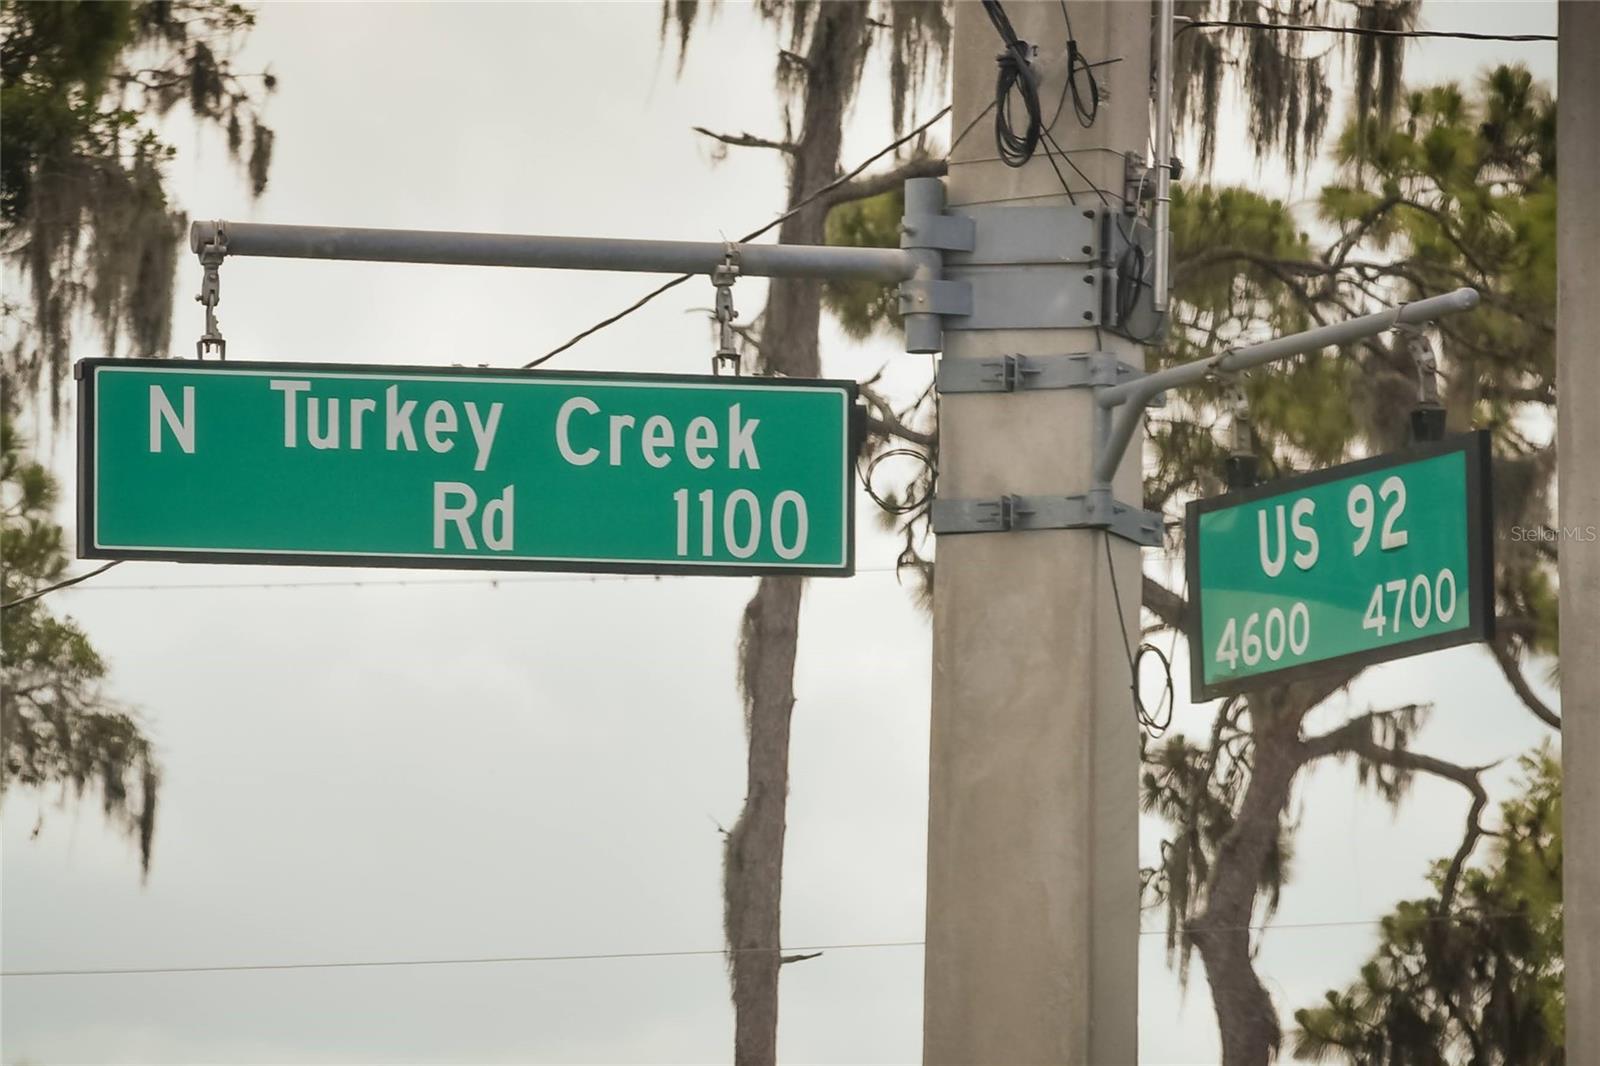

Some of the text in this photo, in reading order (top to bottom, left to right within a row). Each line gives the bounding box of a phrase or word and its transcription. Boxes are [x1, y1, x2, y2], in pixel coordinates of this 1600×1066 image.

[148, 379, 762, 472] N Turkey Creek
[432, 481, 810, 561] Rd 1100
[1257, 475, 1408, 578] US 92
[1215, 568, 1457, 670] 4600 4700
